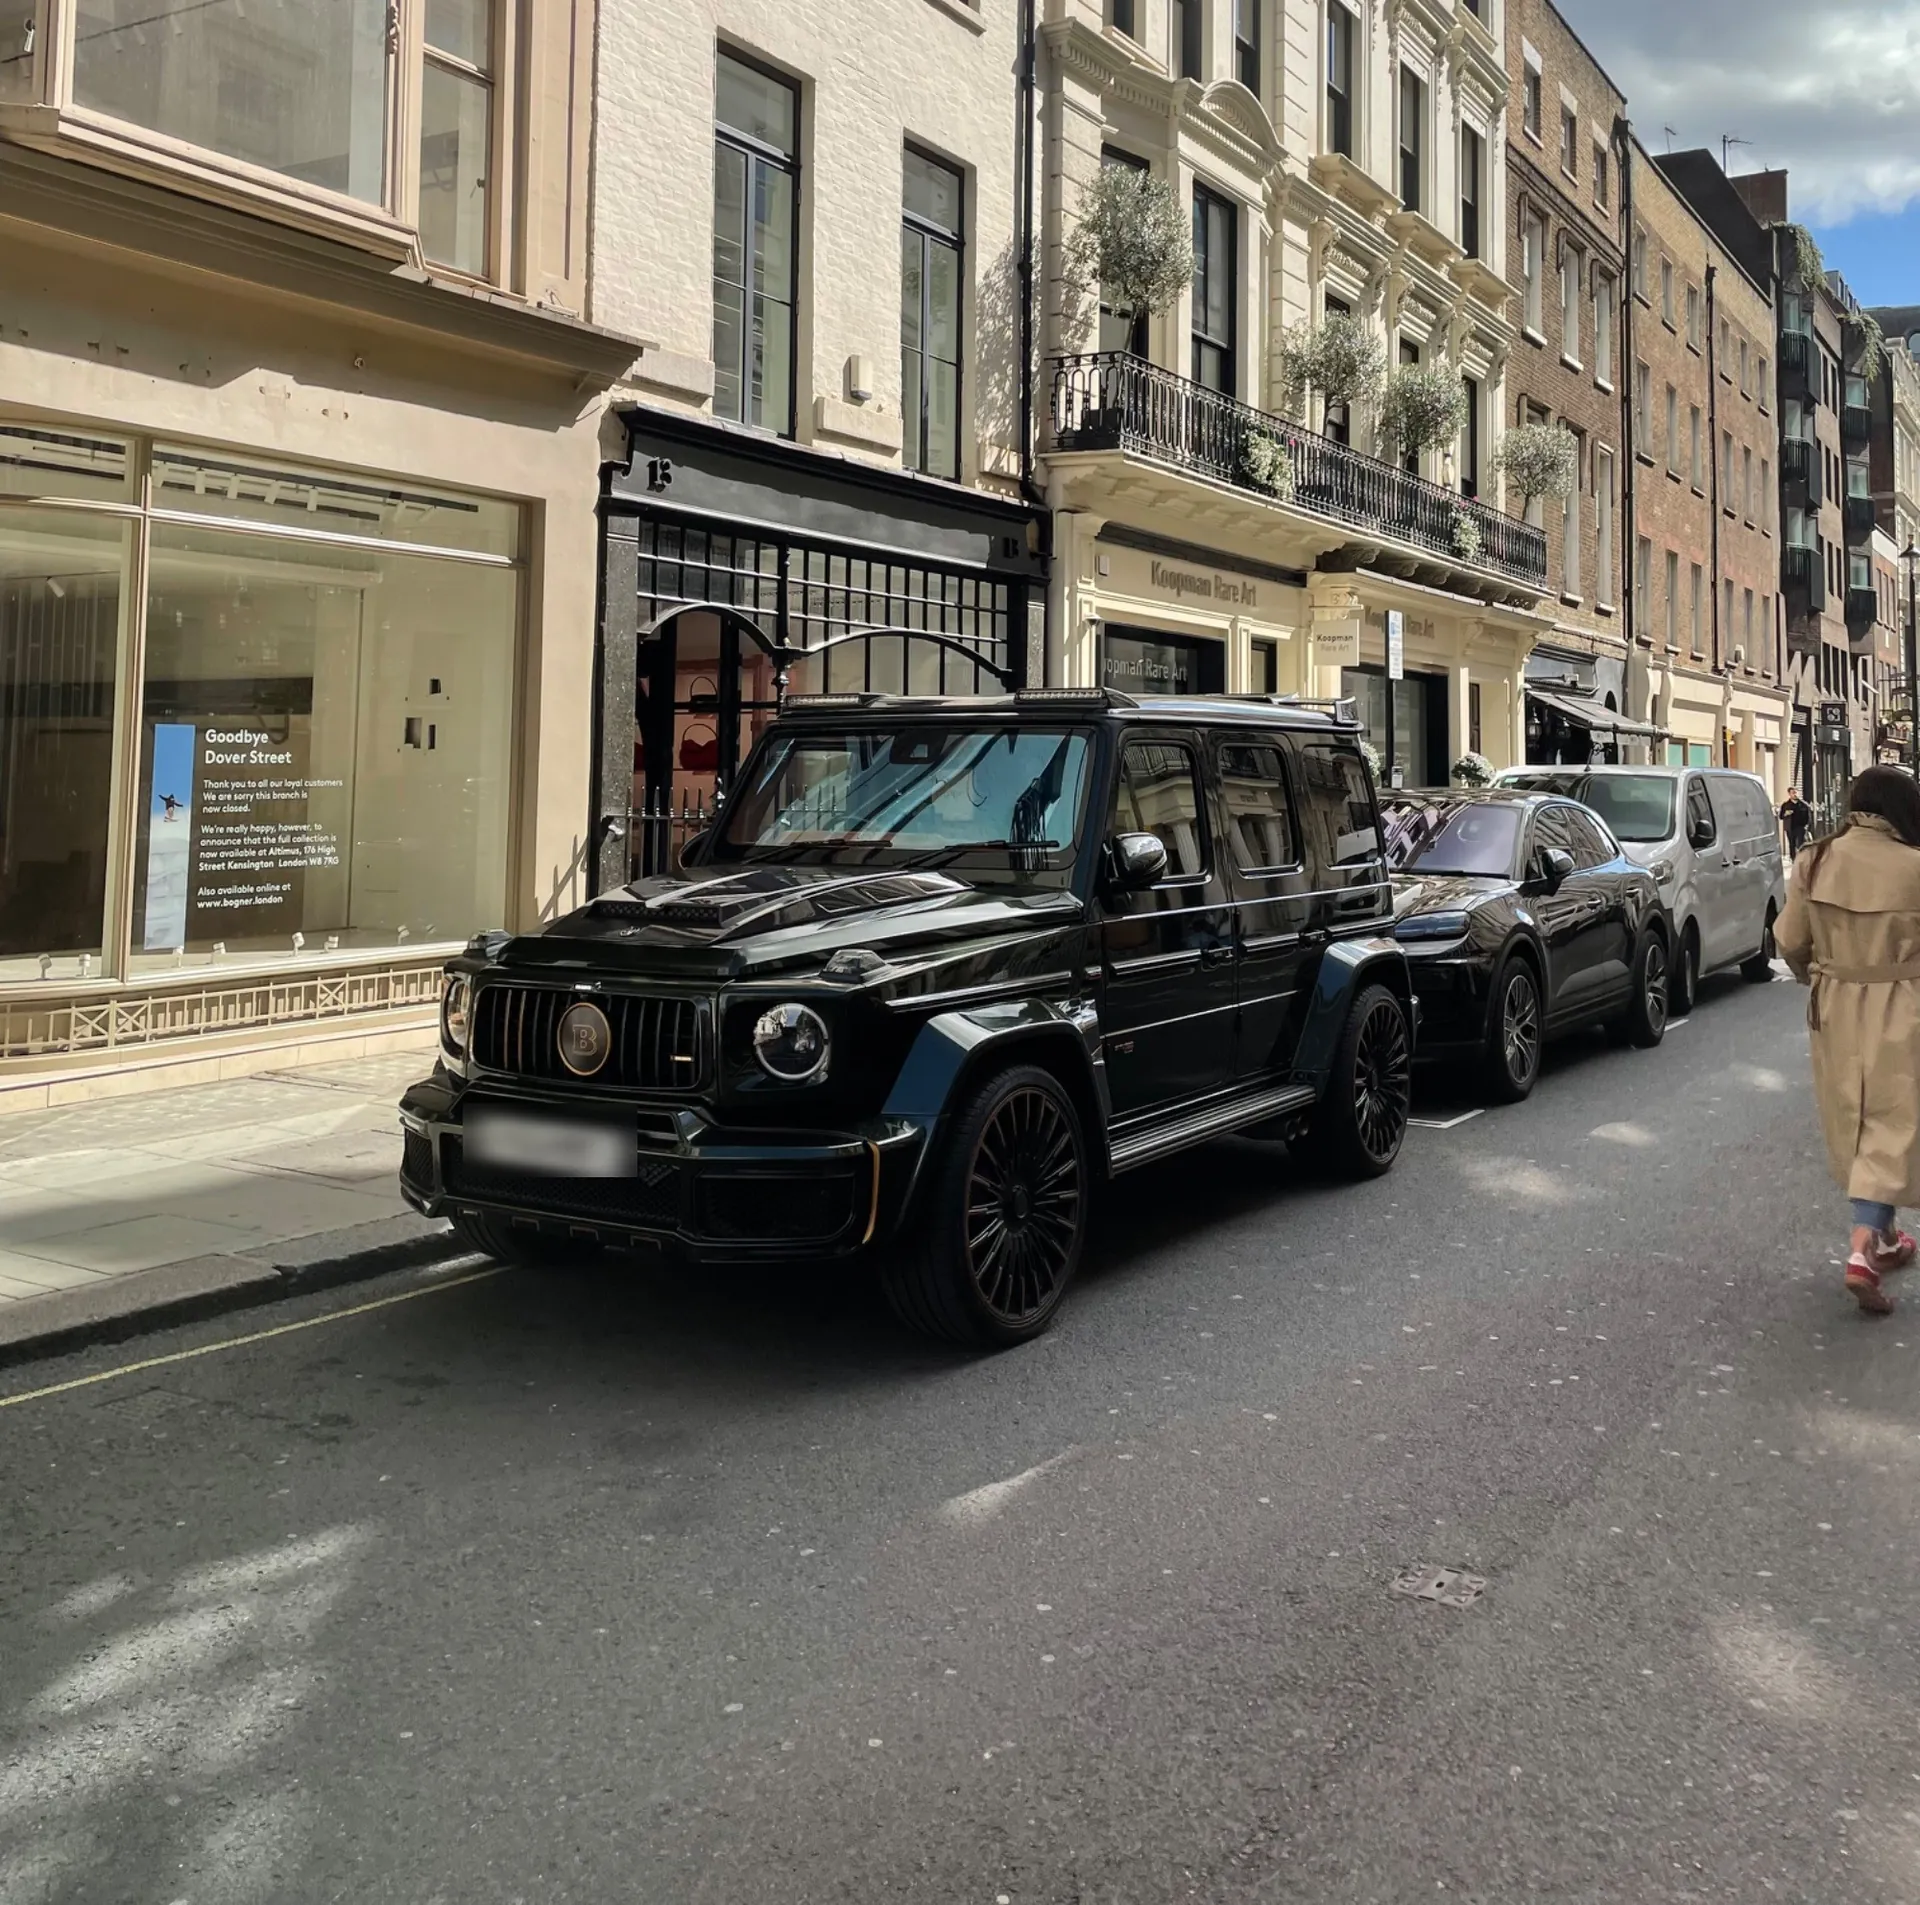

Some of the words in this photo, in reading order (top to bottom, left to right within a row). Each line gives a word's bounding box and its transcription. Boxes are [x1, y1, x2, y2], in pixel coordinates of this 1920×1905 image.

[1151, 561, 1212, 597] Koopman
[1214, 574, 1239, 603] Rare
[1241, 581, 1257, 607] Art
[1316, 634, 1353, 642] Koopman
[1105, 658, 1143, 678] opman
[1146, 658, 1169, 679] Rare
[1172, 663, 1187, 681] Art
[205, 728, 268, 747] Goodbye
[205, 750, 246, 764] Dover
[250, 750, 292, 764] Street
[203, 780, 229, 789] Thank
[231, 781, 246, 790] you
[285, 779, 303, 789] loyal
[234, 793, 254, 802] sorry
[201, 825, 224, 834] We're
[226, 825, 248, 835] really
[250, 825, 276, 835] happy,
[220, 848, 256, 858] available
[268, 847, 302, 856] Altimus,
[318, 846, 336, 855] High
[199, 862, 226, 871] Street
[228, 860, 274, 871] Kensington
[279, 859, 308, 867] London
[198, 887, 216, 896] Also
[218, 885, 254, 895] available
[256, 883, 280, 892] online
[197, 895, 283, 908] www.bogner.london
[572, 1024, 598, 1056] B
